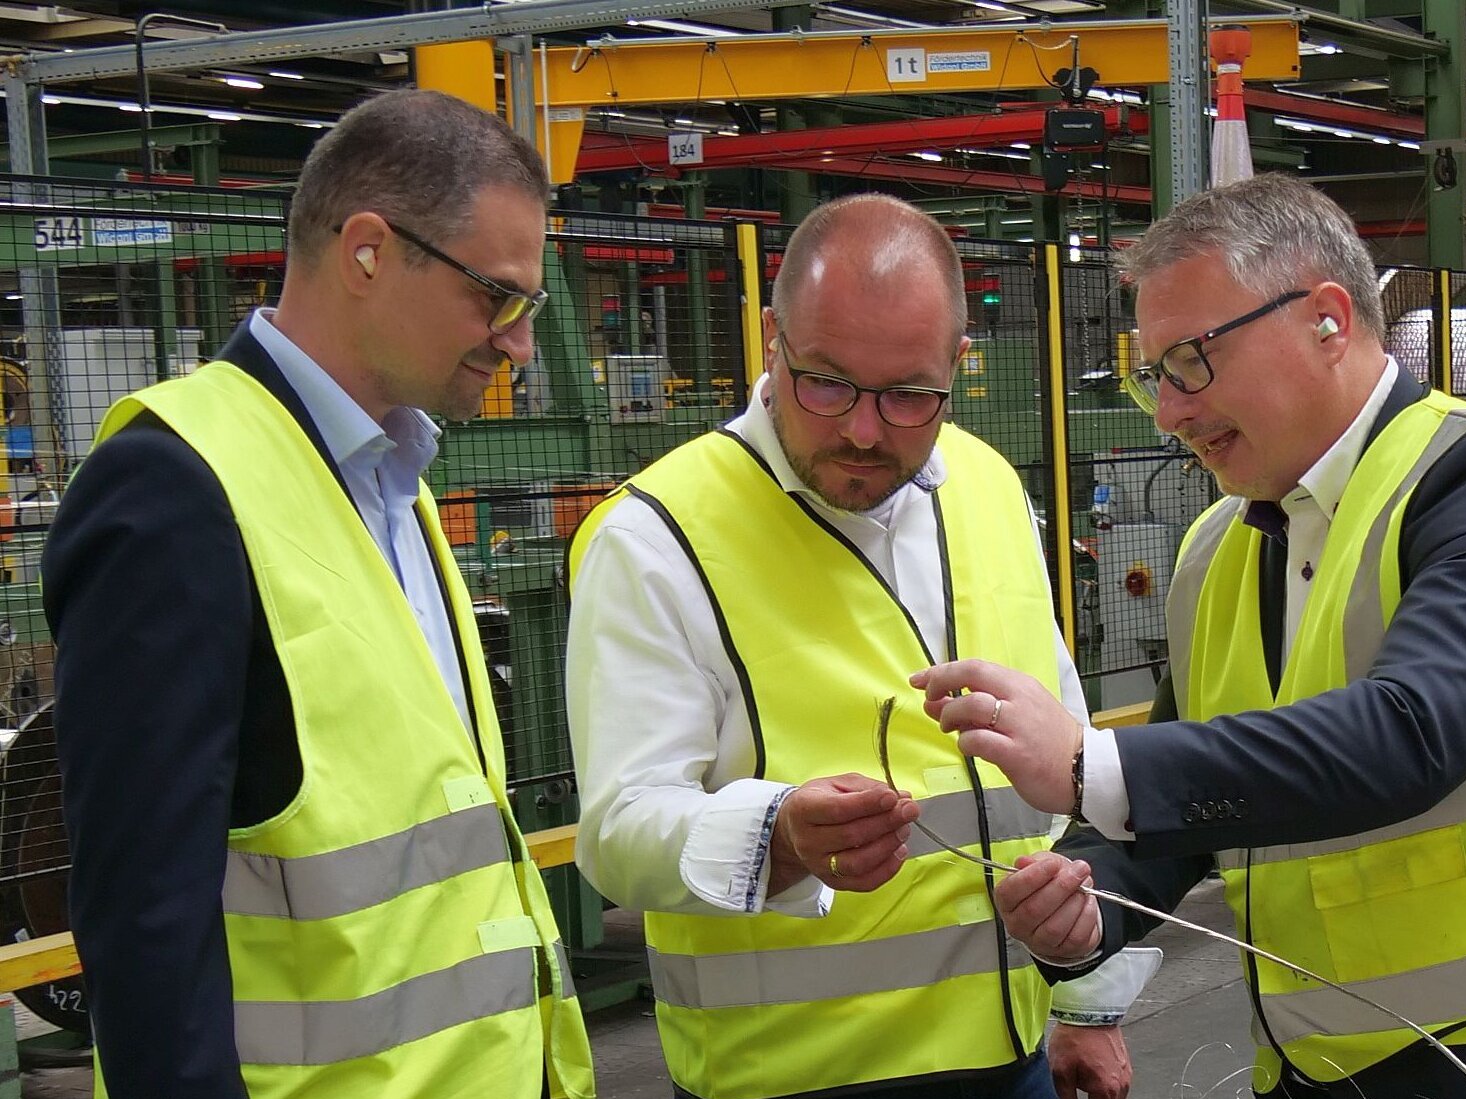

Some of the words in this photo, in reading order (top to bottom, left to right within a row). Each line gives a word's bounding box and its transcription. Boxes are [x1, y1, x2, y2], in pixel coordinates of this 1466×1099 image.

[894, 57, 903, 74] 1
[907, 57, 918, 74] t
[671, 144, 695, 159] 184
[34, 217, 82, 249] 544
